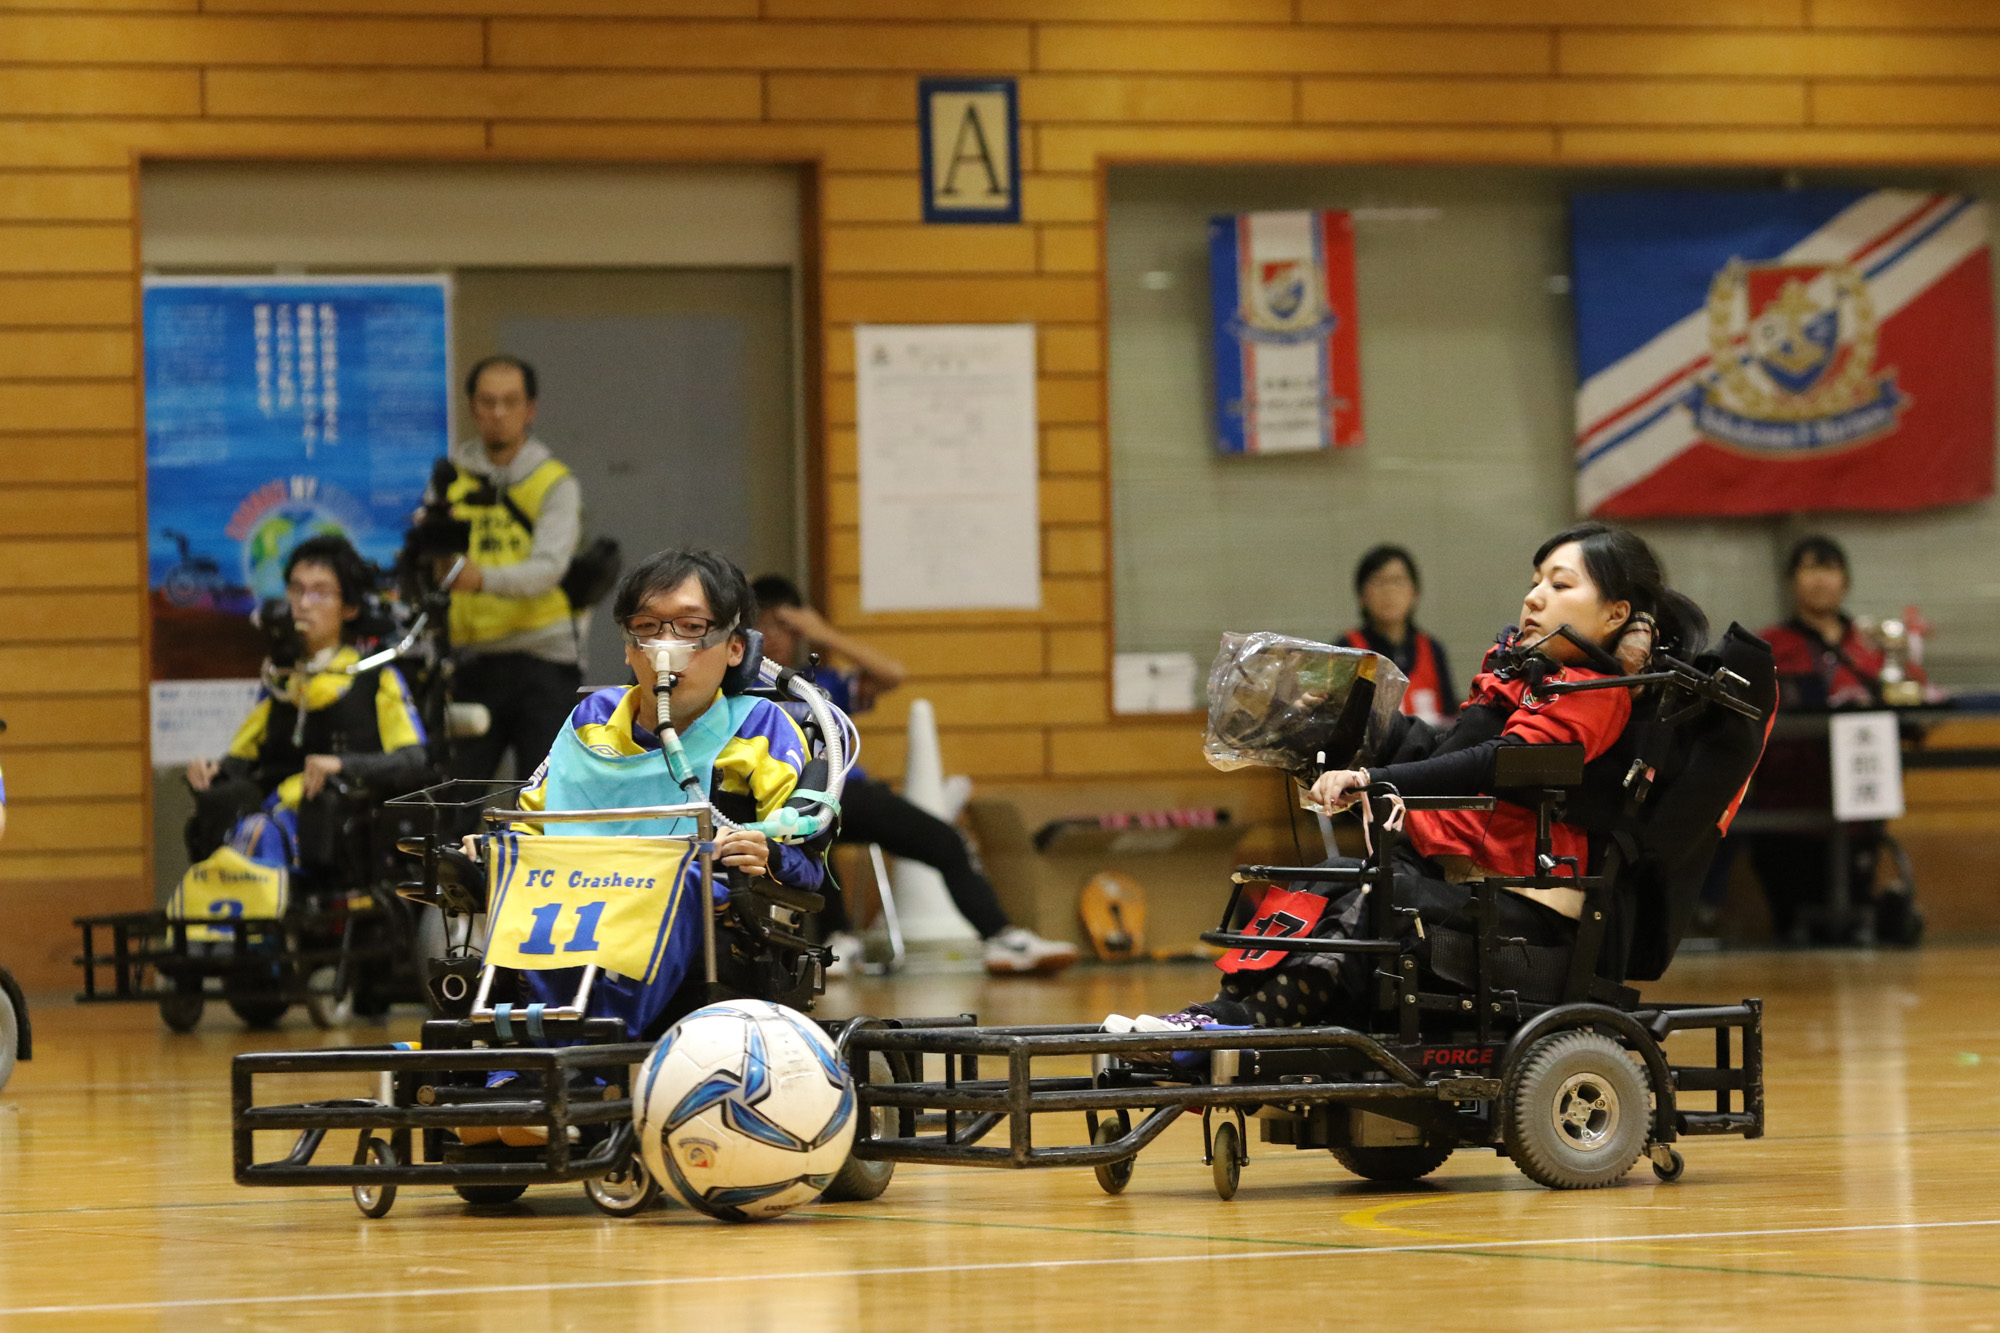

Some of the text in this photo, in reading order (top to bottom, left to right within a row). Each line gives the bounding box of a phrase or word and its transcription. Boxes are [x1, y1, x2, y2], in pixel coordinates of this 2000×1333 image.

[935, 102, 1008, 195] A
[525, 869, 656, 889] FC Crashers
[518, 901, 607, 955] 11
[1238, 910, 1308, 962] 17
[1422, 1048, 1494, 1065] FORCE
